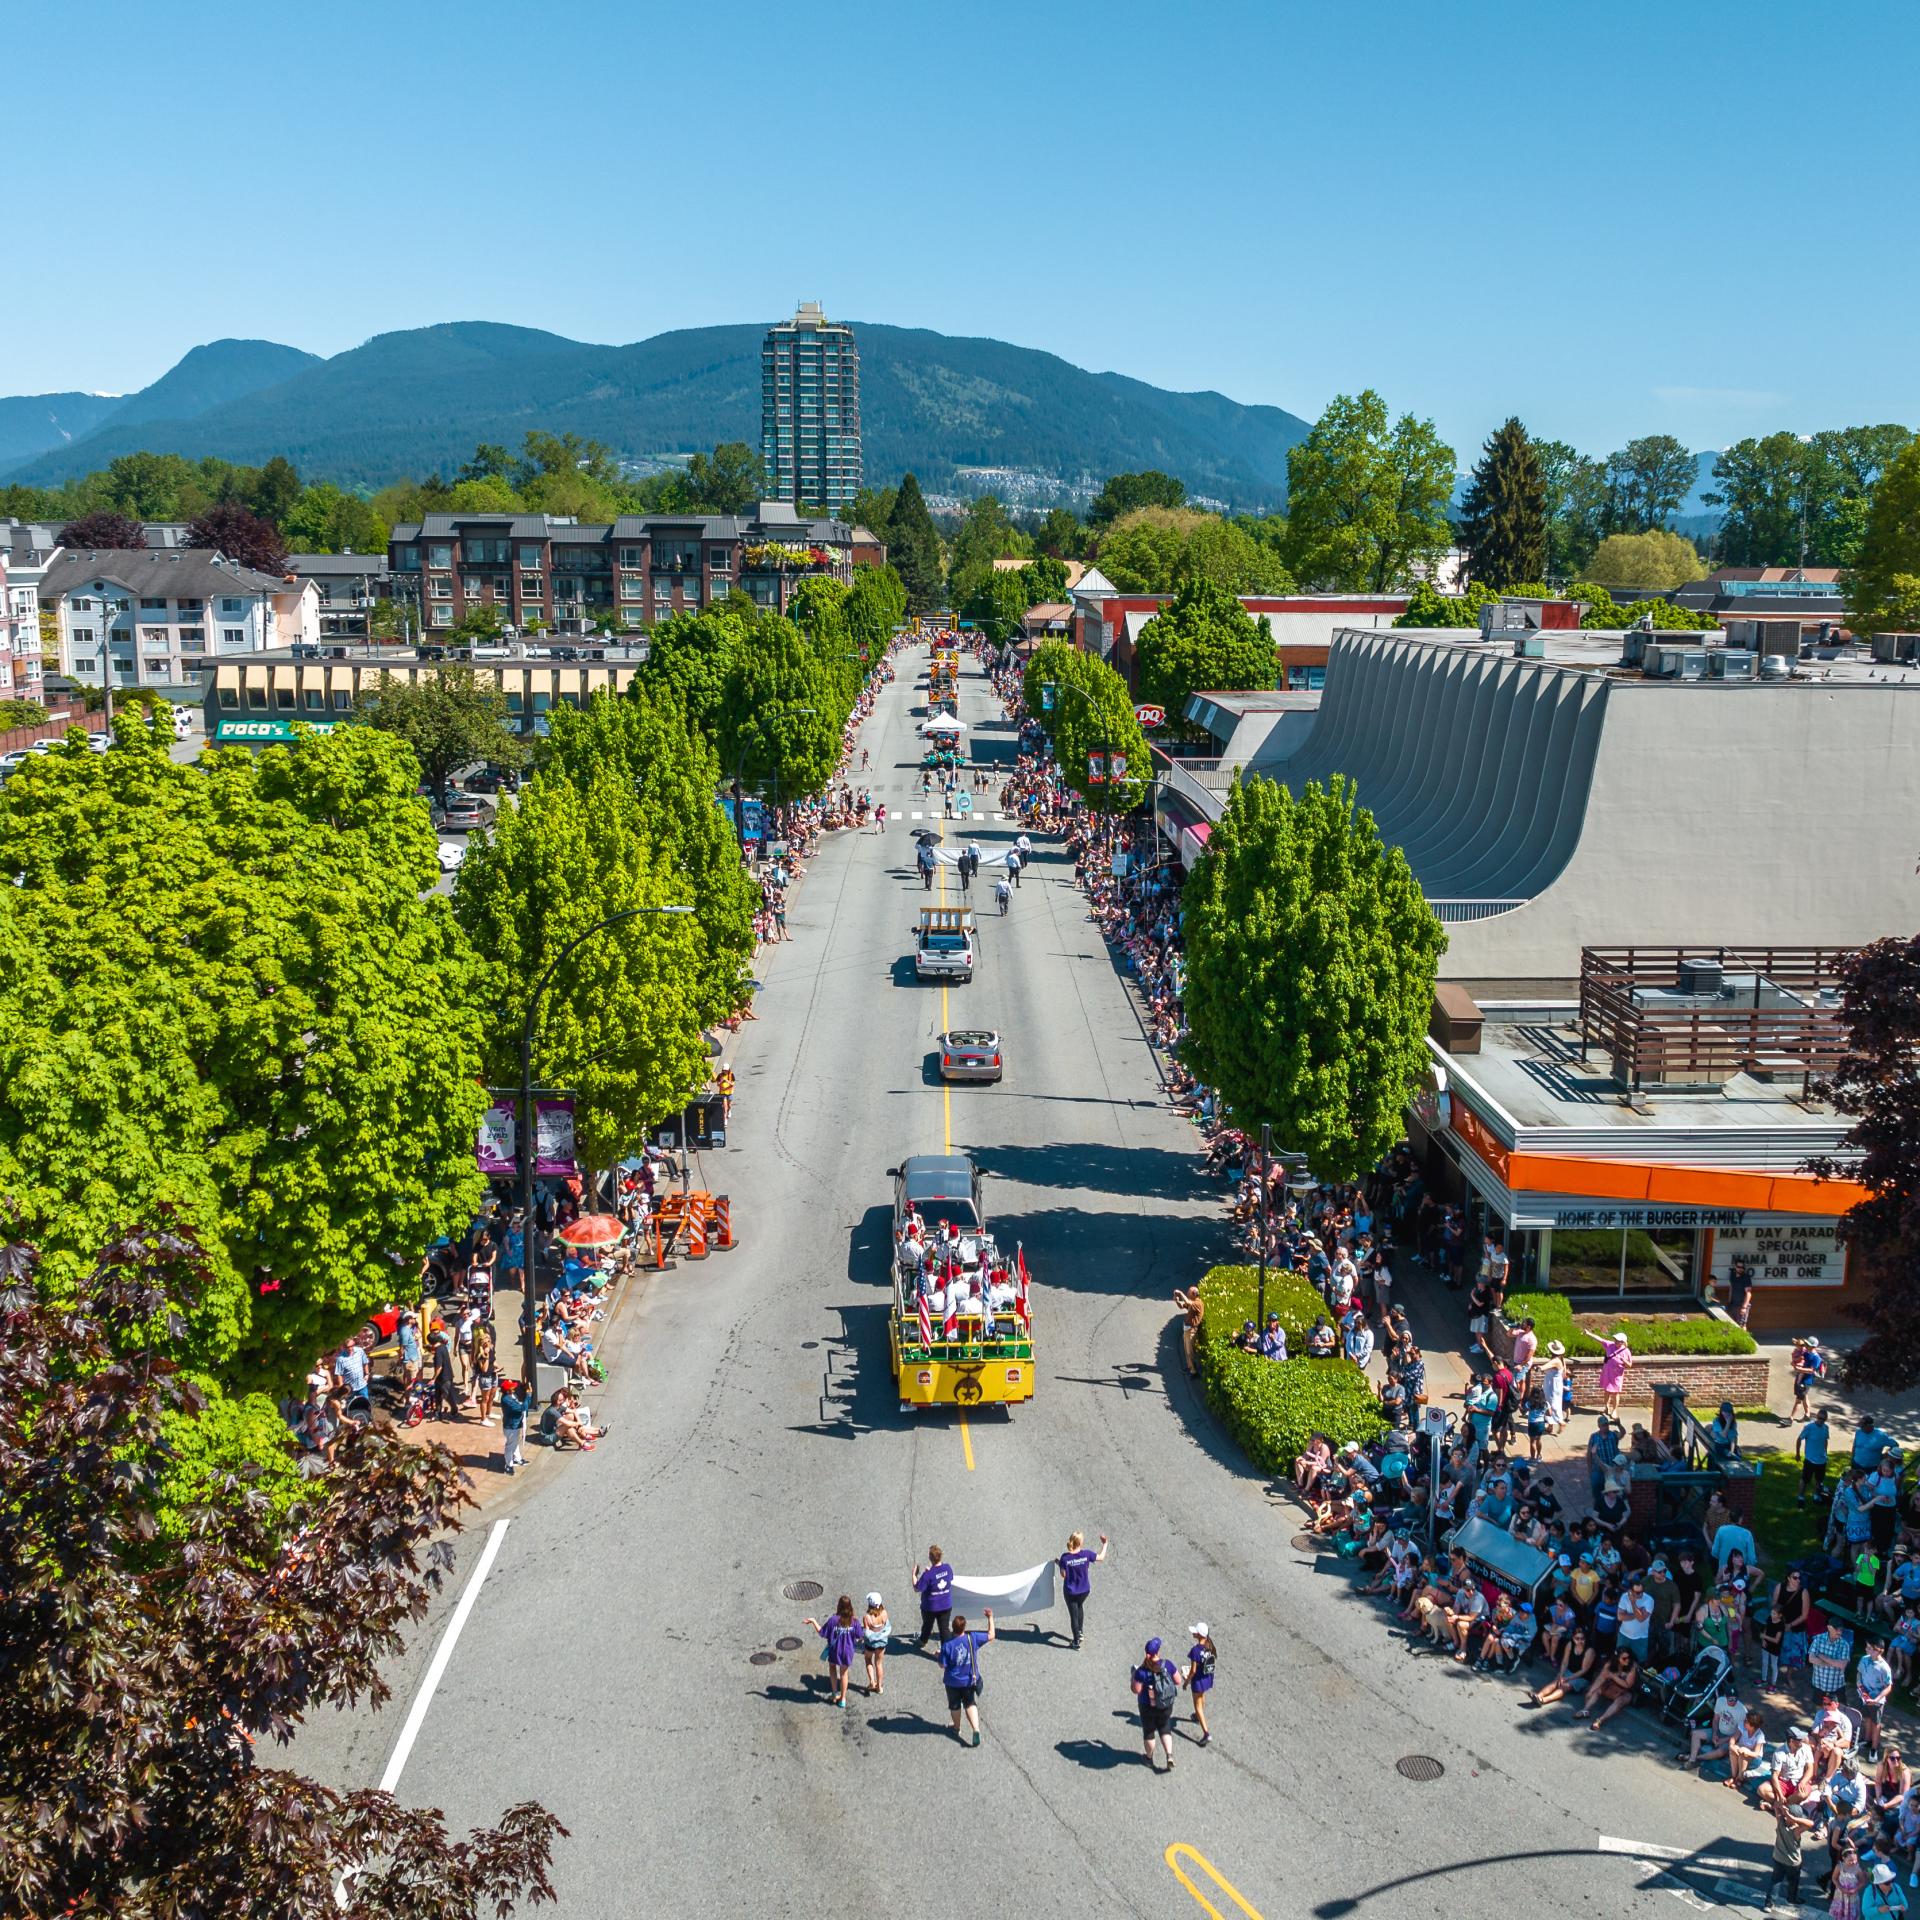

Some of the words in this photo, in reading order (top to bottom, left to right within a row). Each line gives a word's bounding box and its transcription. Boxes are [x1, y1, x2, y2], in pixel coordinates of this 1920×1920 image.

[1139, 710, 1160, 722] DQ
[1557, 1211, 1595, 1226] HOME
[1598, 1211, 1616, 1225] OF
[1619, 1211, 1645, 1225] THE
[1646, 1211, 1697, 1225] BURGER
[1700, 1211, 1746, 1225] FAMILY
[1720, 1227, 1747, 1238] MAY
[1755, 1227, 1783, 1238] DAY
[1790, 1227, 1836, 1238] PARAD
[1757, 1241, 1809, 1251] SPECIAL
[1731, 1254, 1768, 1265] MAMA
[1778, 1254, 1827, 1265] BURGER
[1728, 1267, 1755, 1277] TO
[1764, 1267, 1788, 1277] FOR
[1797, 1267, 1822, 1277] ONE
[1490, 1571, 1522, 1596] Piping?
